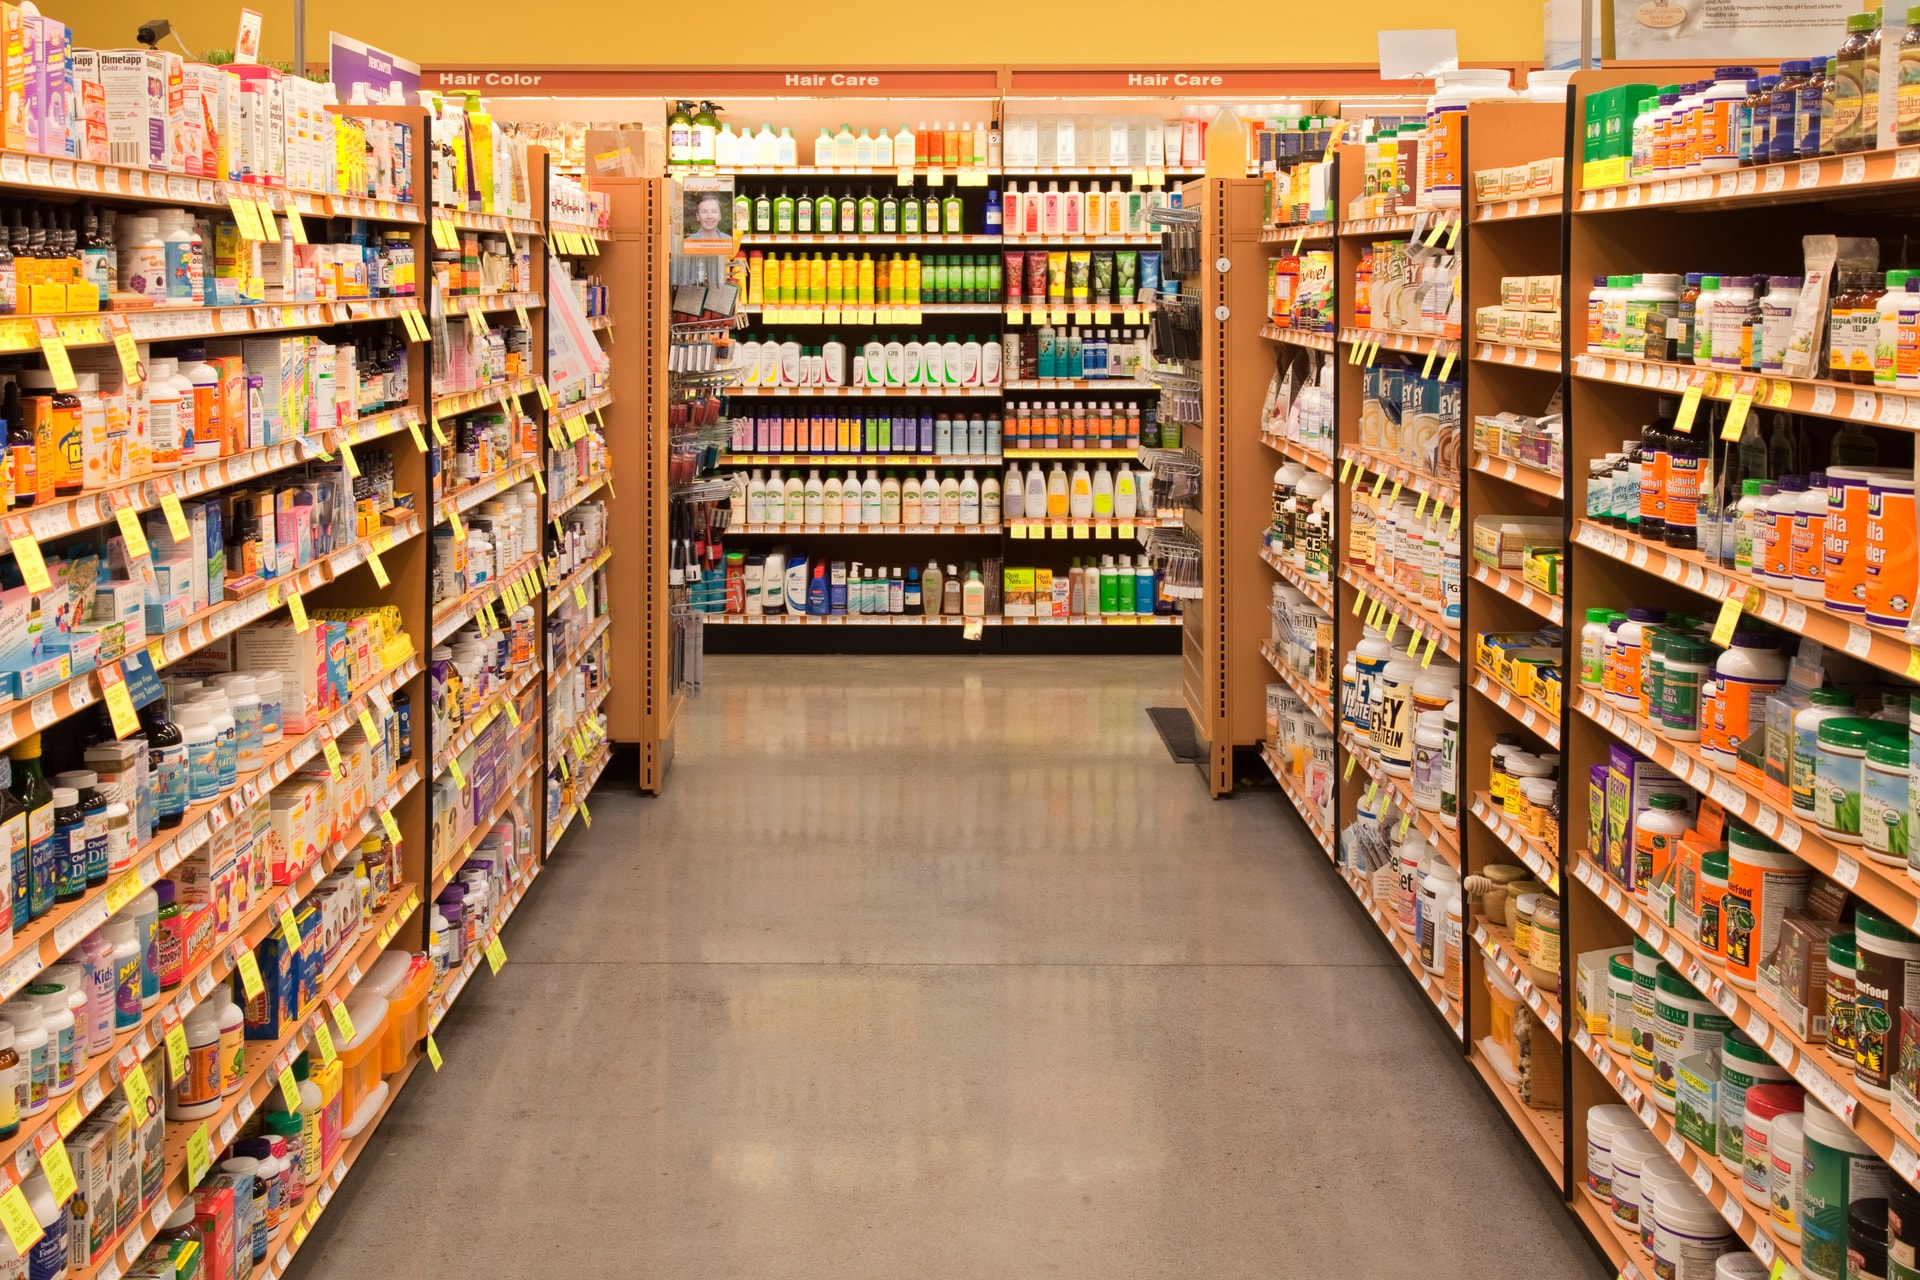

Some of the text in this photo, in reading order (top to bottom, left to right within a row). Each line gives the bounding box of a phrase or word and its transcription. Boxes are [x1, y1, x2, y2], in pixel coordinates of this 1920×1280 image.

[101, 56, 142, 65] Dimetapp
[439, 73, 541, 86] Hair Color
[785, 74, 879, 86] Hair Care
[1128, 74, 1223, 86] Hair Care
[1403, 384, 1413, 403] EY
[1414, 386, 1424, 407] EY
[1441, 394, 1454, 416] EY
[1672, 477, 1696, 486] Liquid
[1867, 543, 1886, 563] der
[1005, 568, 1020, 580] Quit
[1037, 571, 1049, 582] Quit
[1040, 578, 1052, 586] Nits
[142, 675, 153, 686] Free
[144, 683, 161, 696] Tablets
[1382, 696, 1404, 730] EY
[1382, 729, 1404, 749] TEIN
[1443, 737, 1455, 760] EY
[1794, 765, 1806, 777] eat
[1611, 774, 1626, 800] BERRY
[88, 846, 108, 864] DH
[73, 864, 85, 879] DH
[94, 967, 112, 985] Kids
[1728, 1088, 1746, 1102] GREEN
